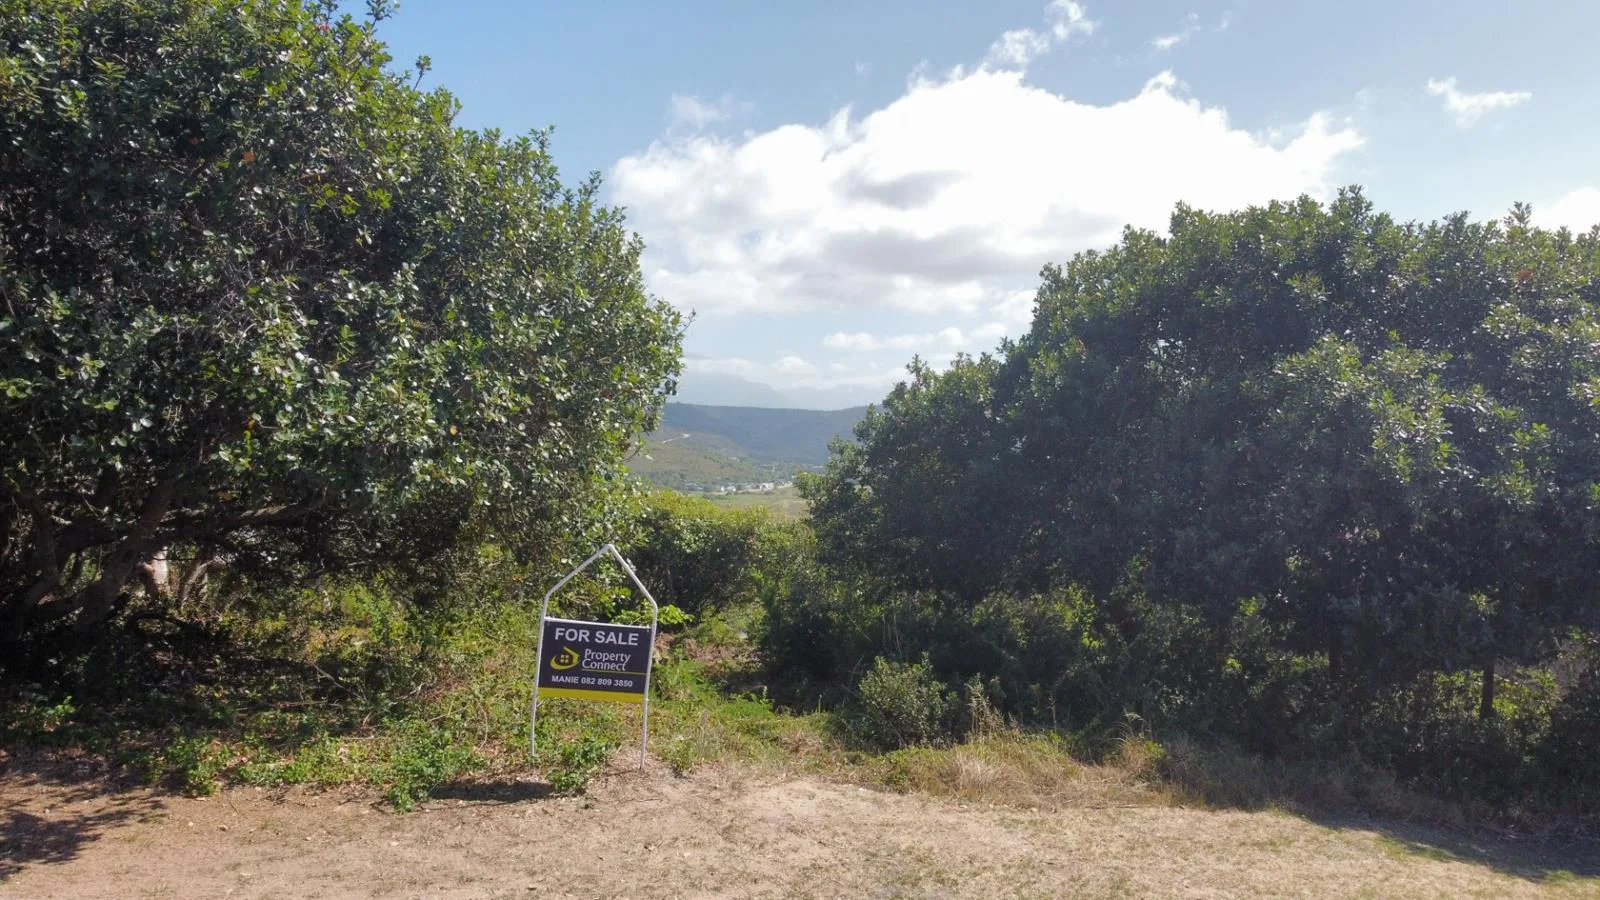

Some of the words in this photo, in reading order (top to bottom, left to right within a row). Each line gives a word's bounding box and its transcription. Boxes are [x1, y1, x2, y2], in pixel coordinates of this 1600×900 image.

[554, 627, 590, 643] FOR
[595, 630, 639, 646] SALE
[584, 648, 631, 663] Property
[581, 658, 626, 671] Connect
[551, 675, 579, 684] MANIE
[581, 677, 596, 685] 082
[597, 678, 612, 686] 809
[614, 679, 633, 687] 3850
